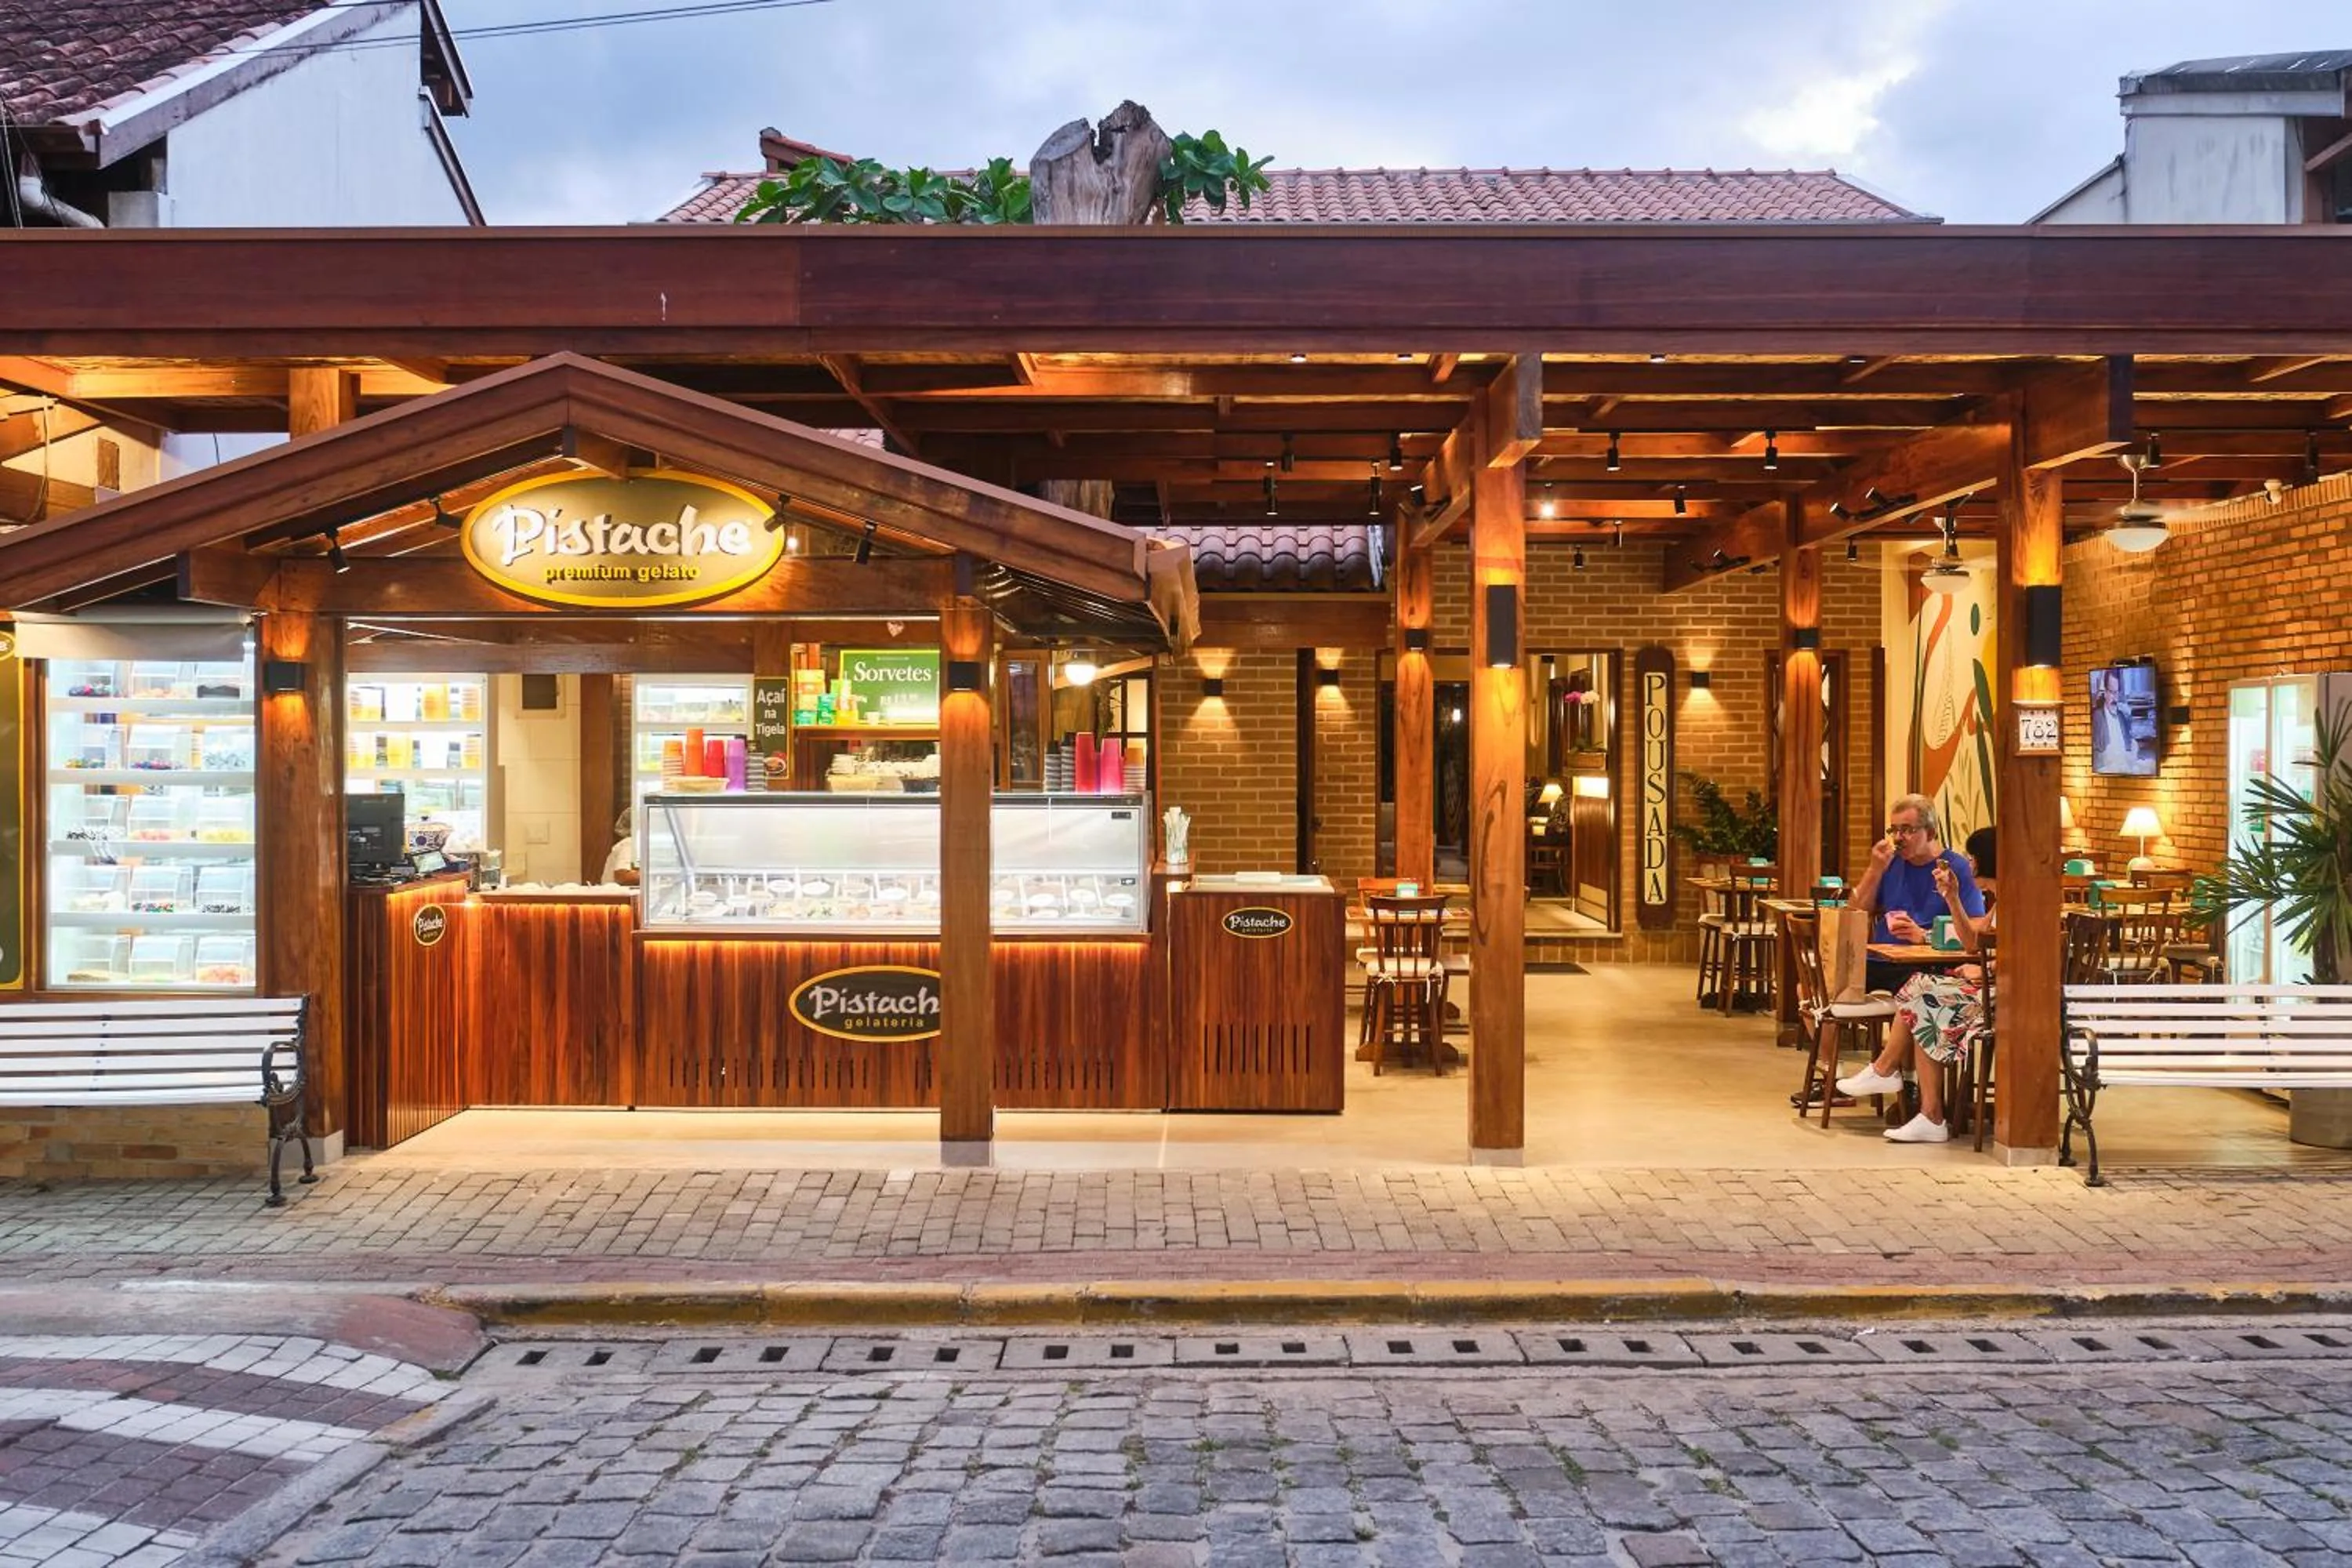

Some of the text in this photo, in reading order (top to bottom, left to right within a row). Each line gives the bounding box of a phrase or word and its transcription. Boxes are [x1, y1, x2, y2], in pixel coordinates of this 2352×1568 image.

[492, 504, 752, 566] Pistache
[545, 564, 701, 583] premium gelato
[853, 661, 931, 682] Sorvetes
[757, 688, 786, 706] Açaí
[764, 709, 777, 719] na
[755, 722, 786, 737] Tigela
[2021, 719, 2057, 739] 782
[1645, 674, 1667, 902] POUSADA
[1229, 914, 1287, 929] Pistache
[808, 985, 940, 1020] Pistach
[844, 1017, 925, 1030] gelateria
